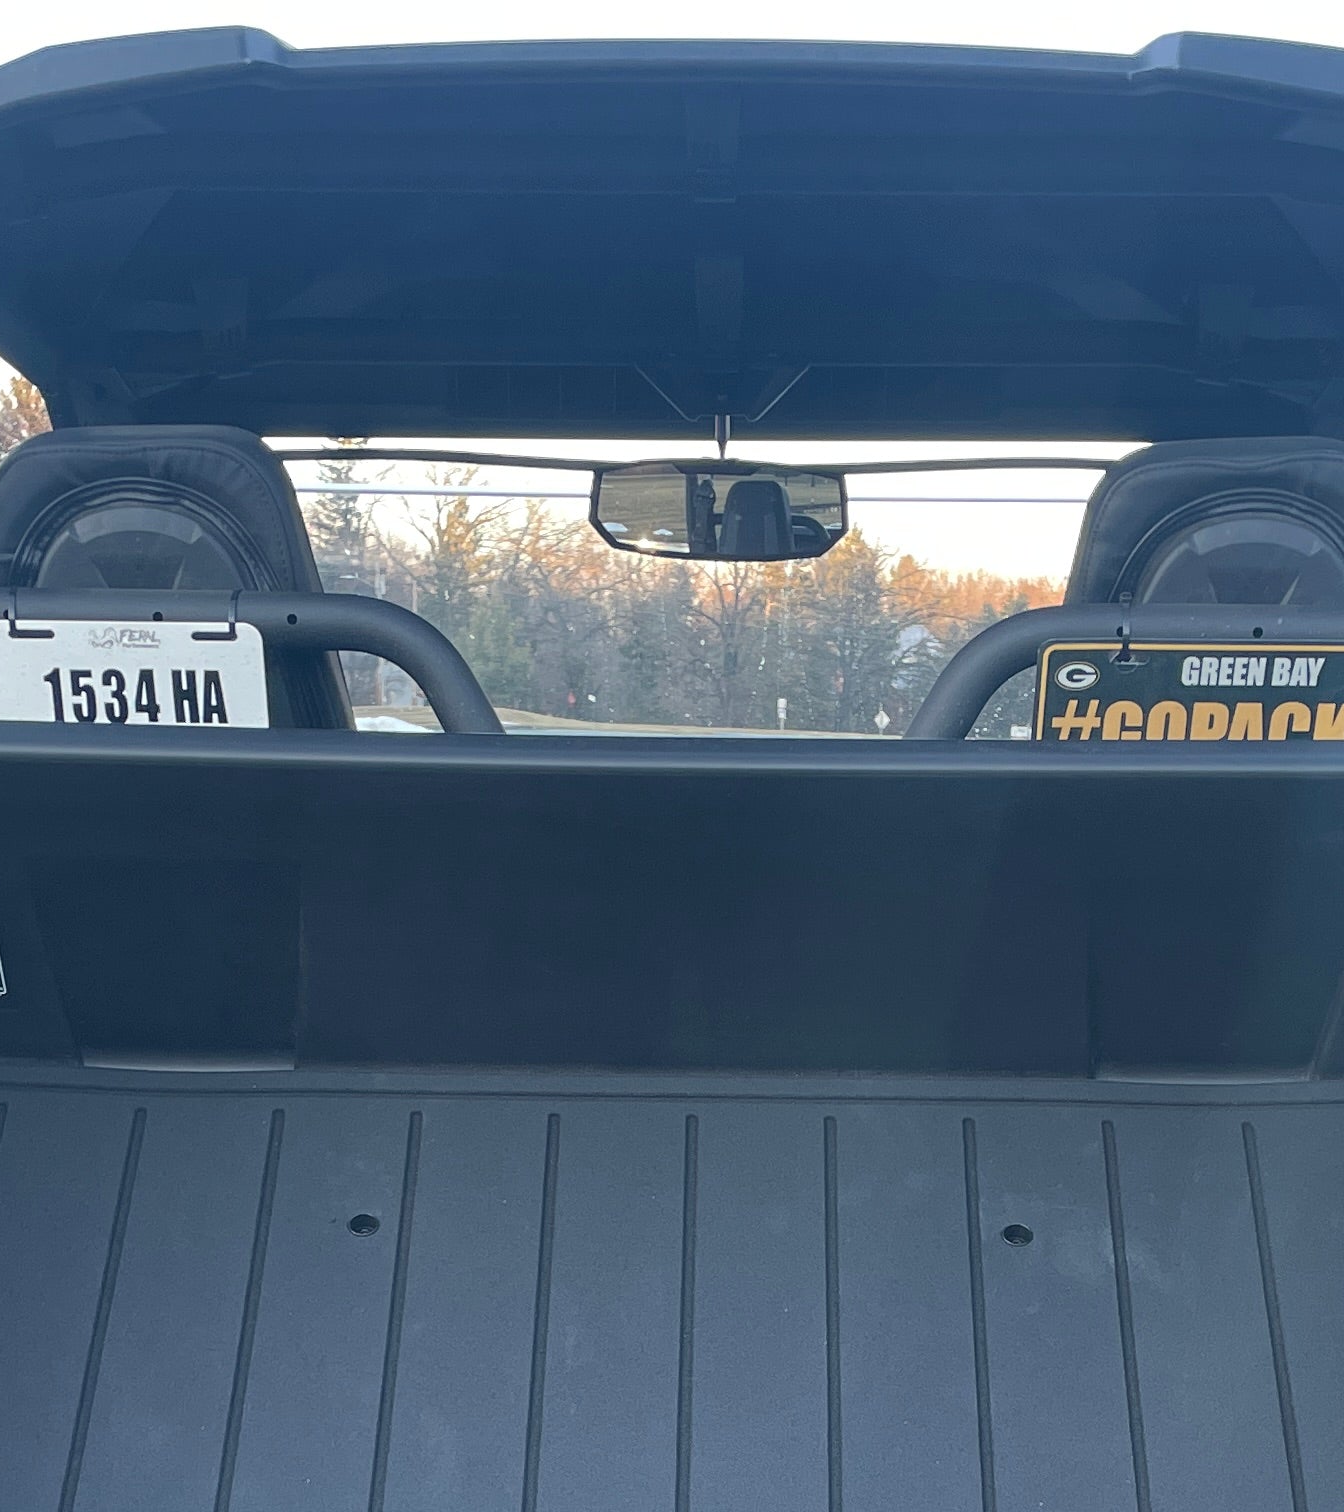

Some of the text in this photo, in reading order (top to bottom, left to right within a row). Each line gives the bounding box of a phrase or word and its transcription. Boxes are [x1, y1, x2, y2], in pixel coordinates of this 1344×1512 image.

[1181, 657, 1325, 687] GREEN BAY
[44, 668, 229, 724] 1534 HA
